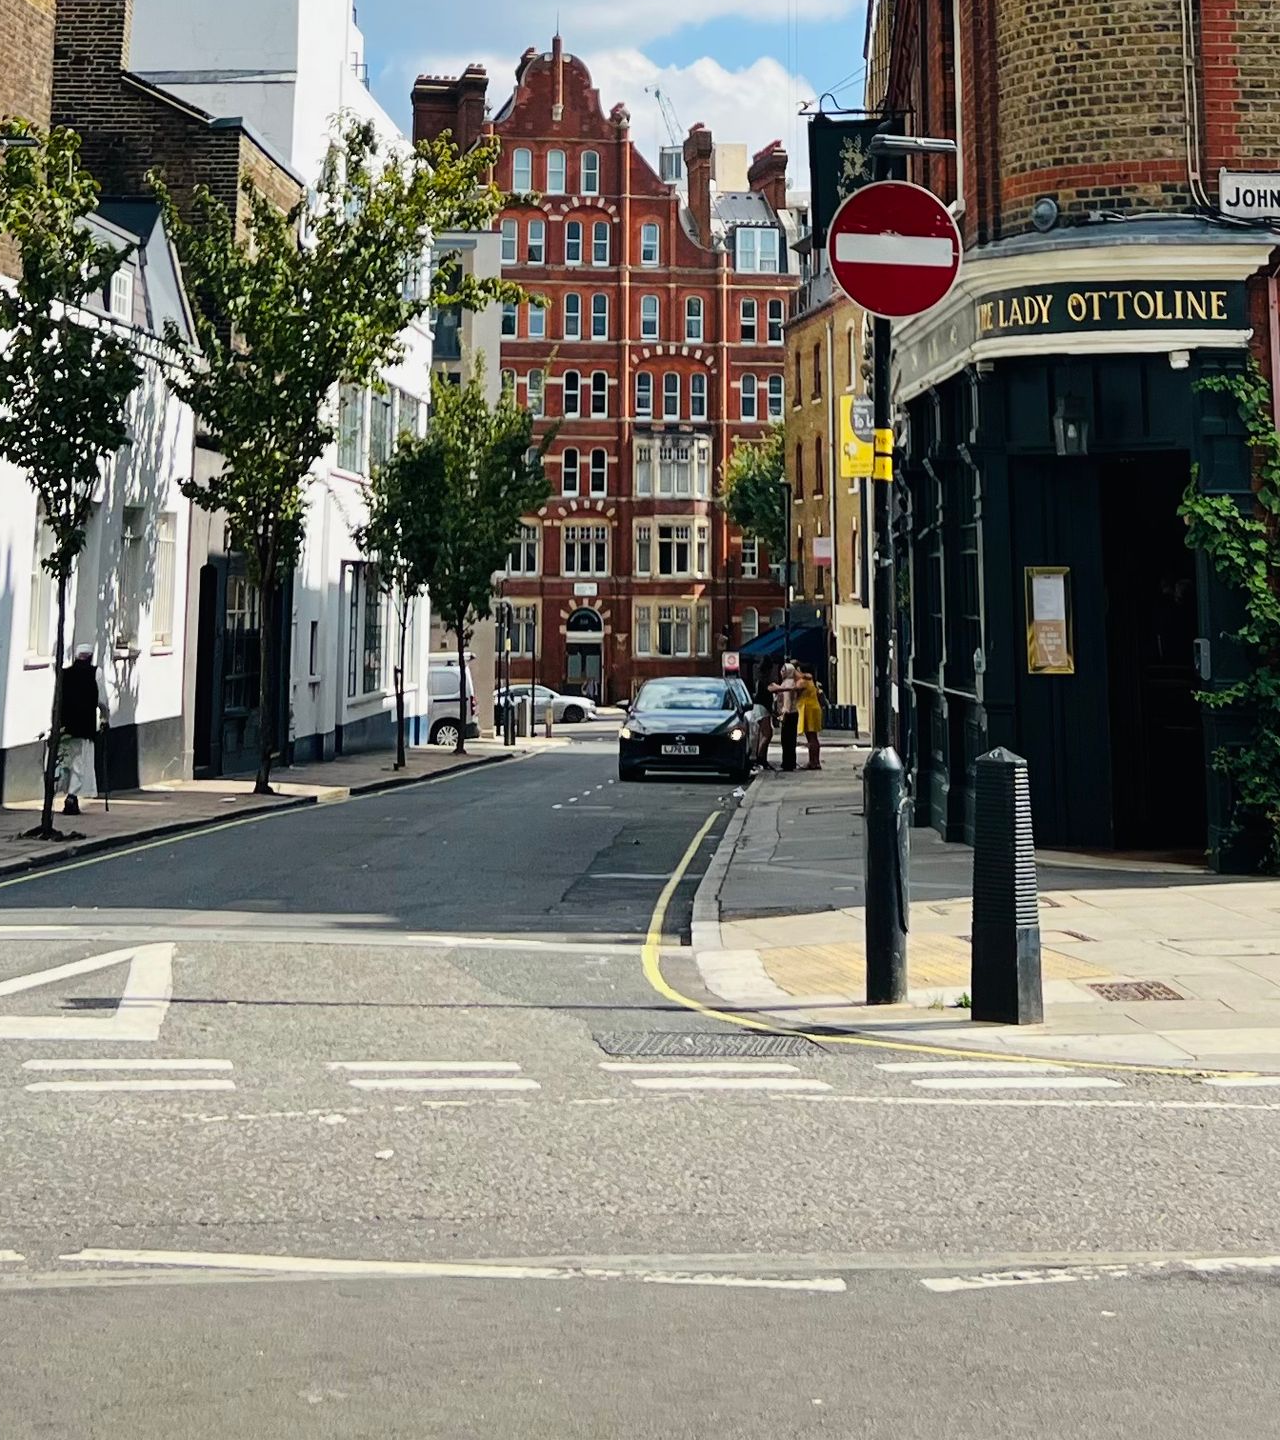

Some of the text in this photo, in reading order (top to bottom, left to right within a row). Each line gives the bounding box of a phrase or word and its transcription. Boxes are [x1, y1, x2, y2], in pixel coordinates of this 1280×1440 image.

[1225, 186, 1280, 208] JOHN
[998, 294, 1053, 328] LADY
[1067, 290, 1228, 321] OTTOLINE
